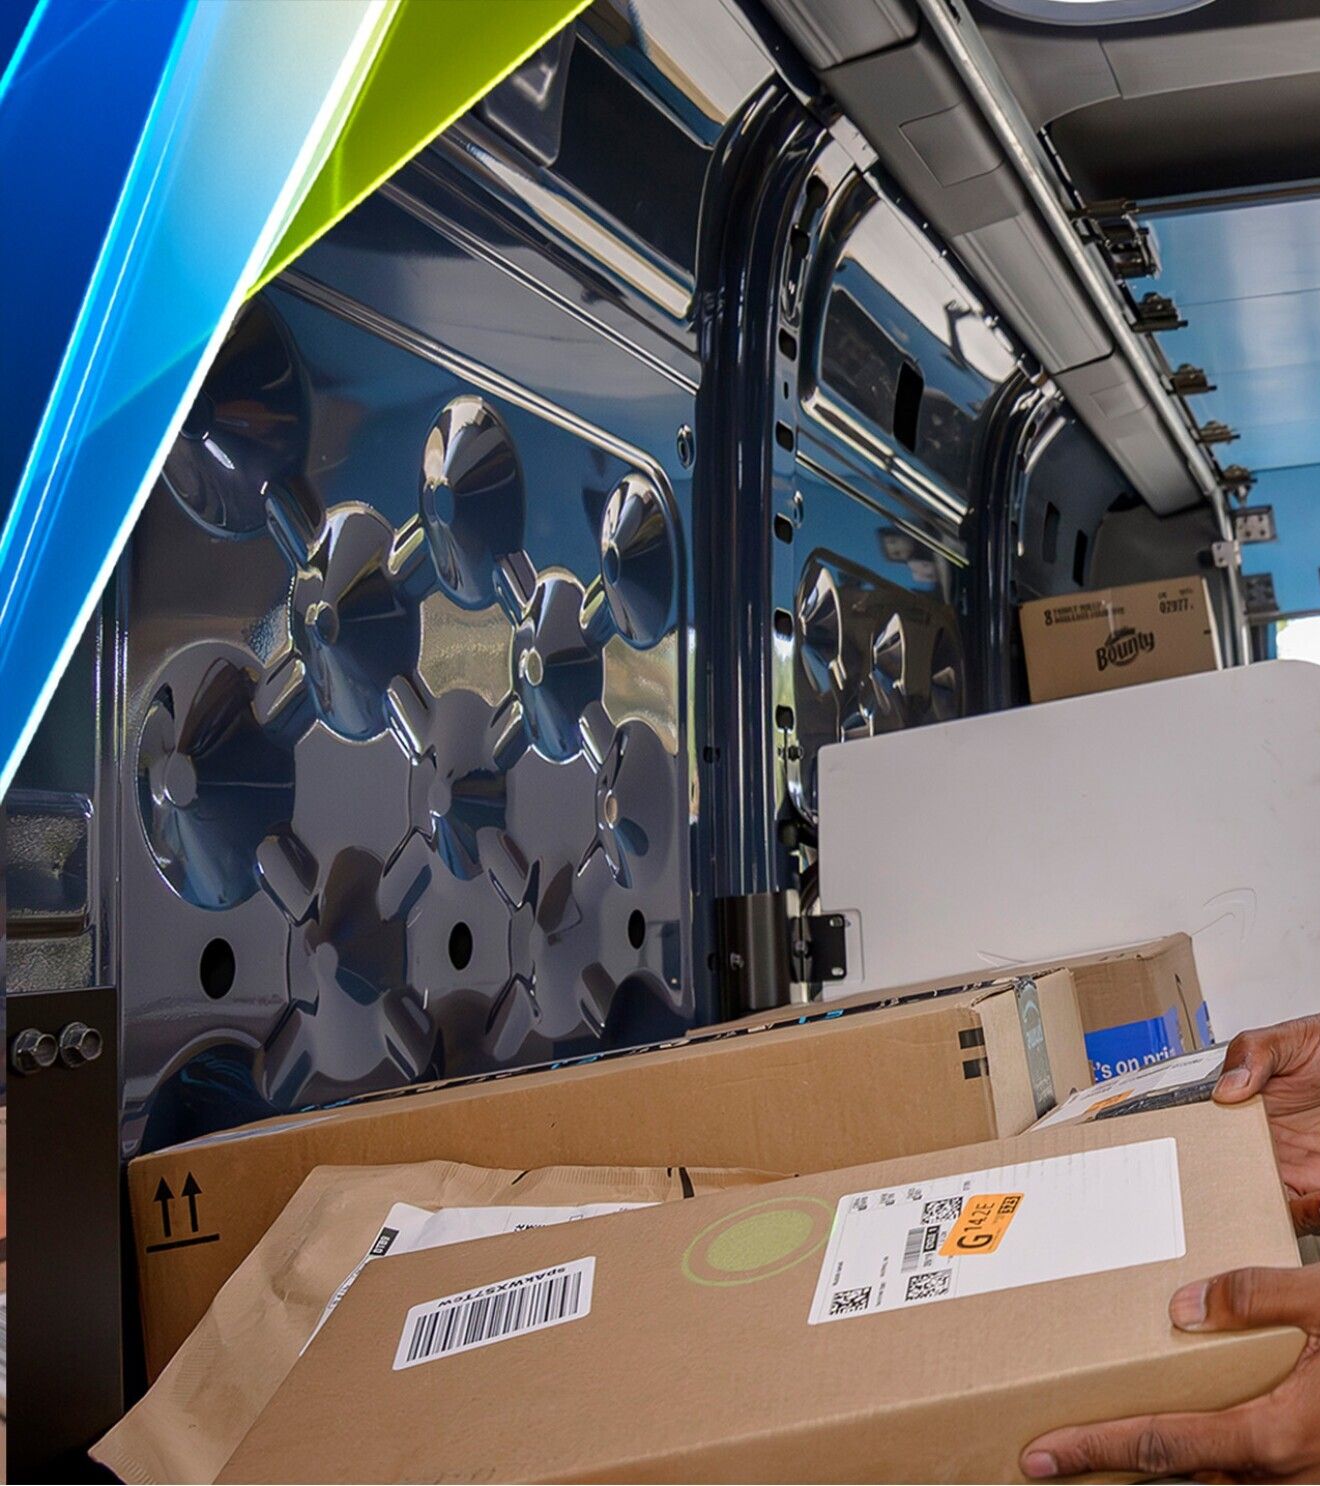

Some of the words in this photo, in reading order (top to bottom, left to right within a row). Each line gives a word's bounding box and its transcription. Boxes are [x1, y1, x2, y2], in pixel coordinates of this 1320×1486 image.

[1096, 632, 1155, 671] Bounty
[1116, 1057, 1141, 1076] on
[957, 1234, 993, 1249] G
